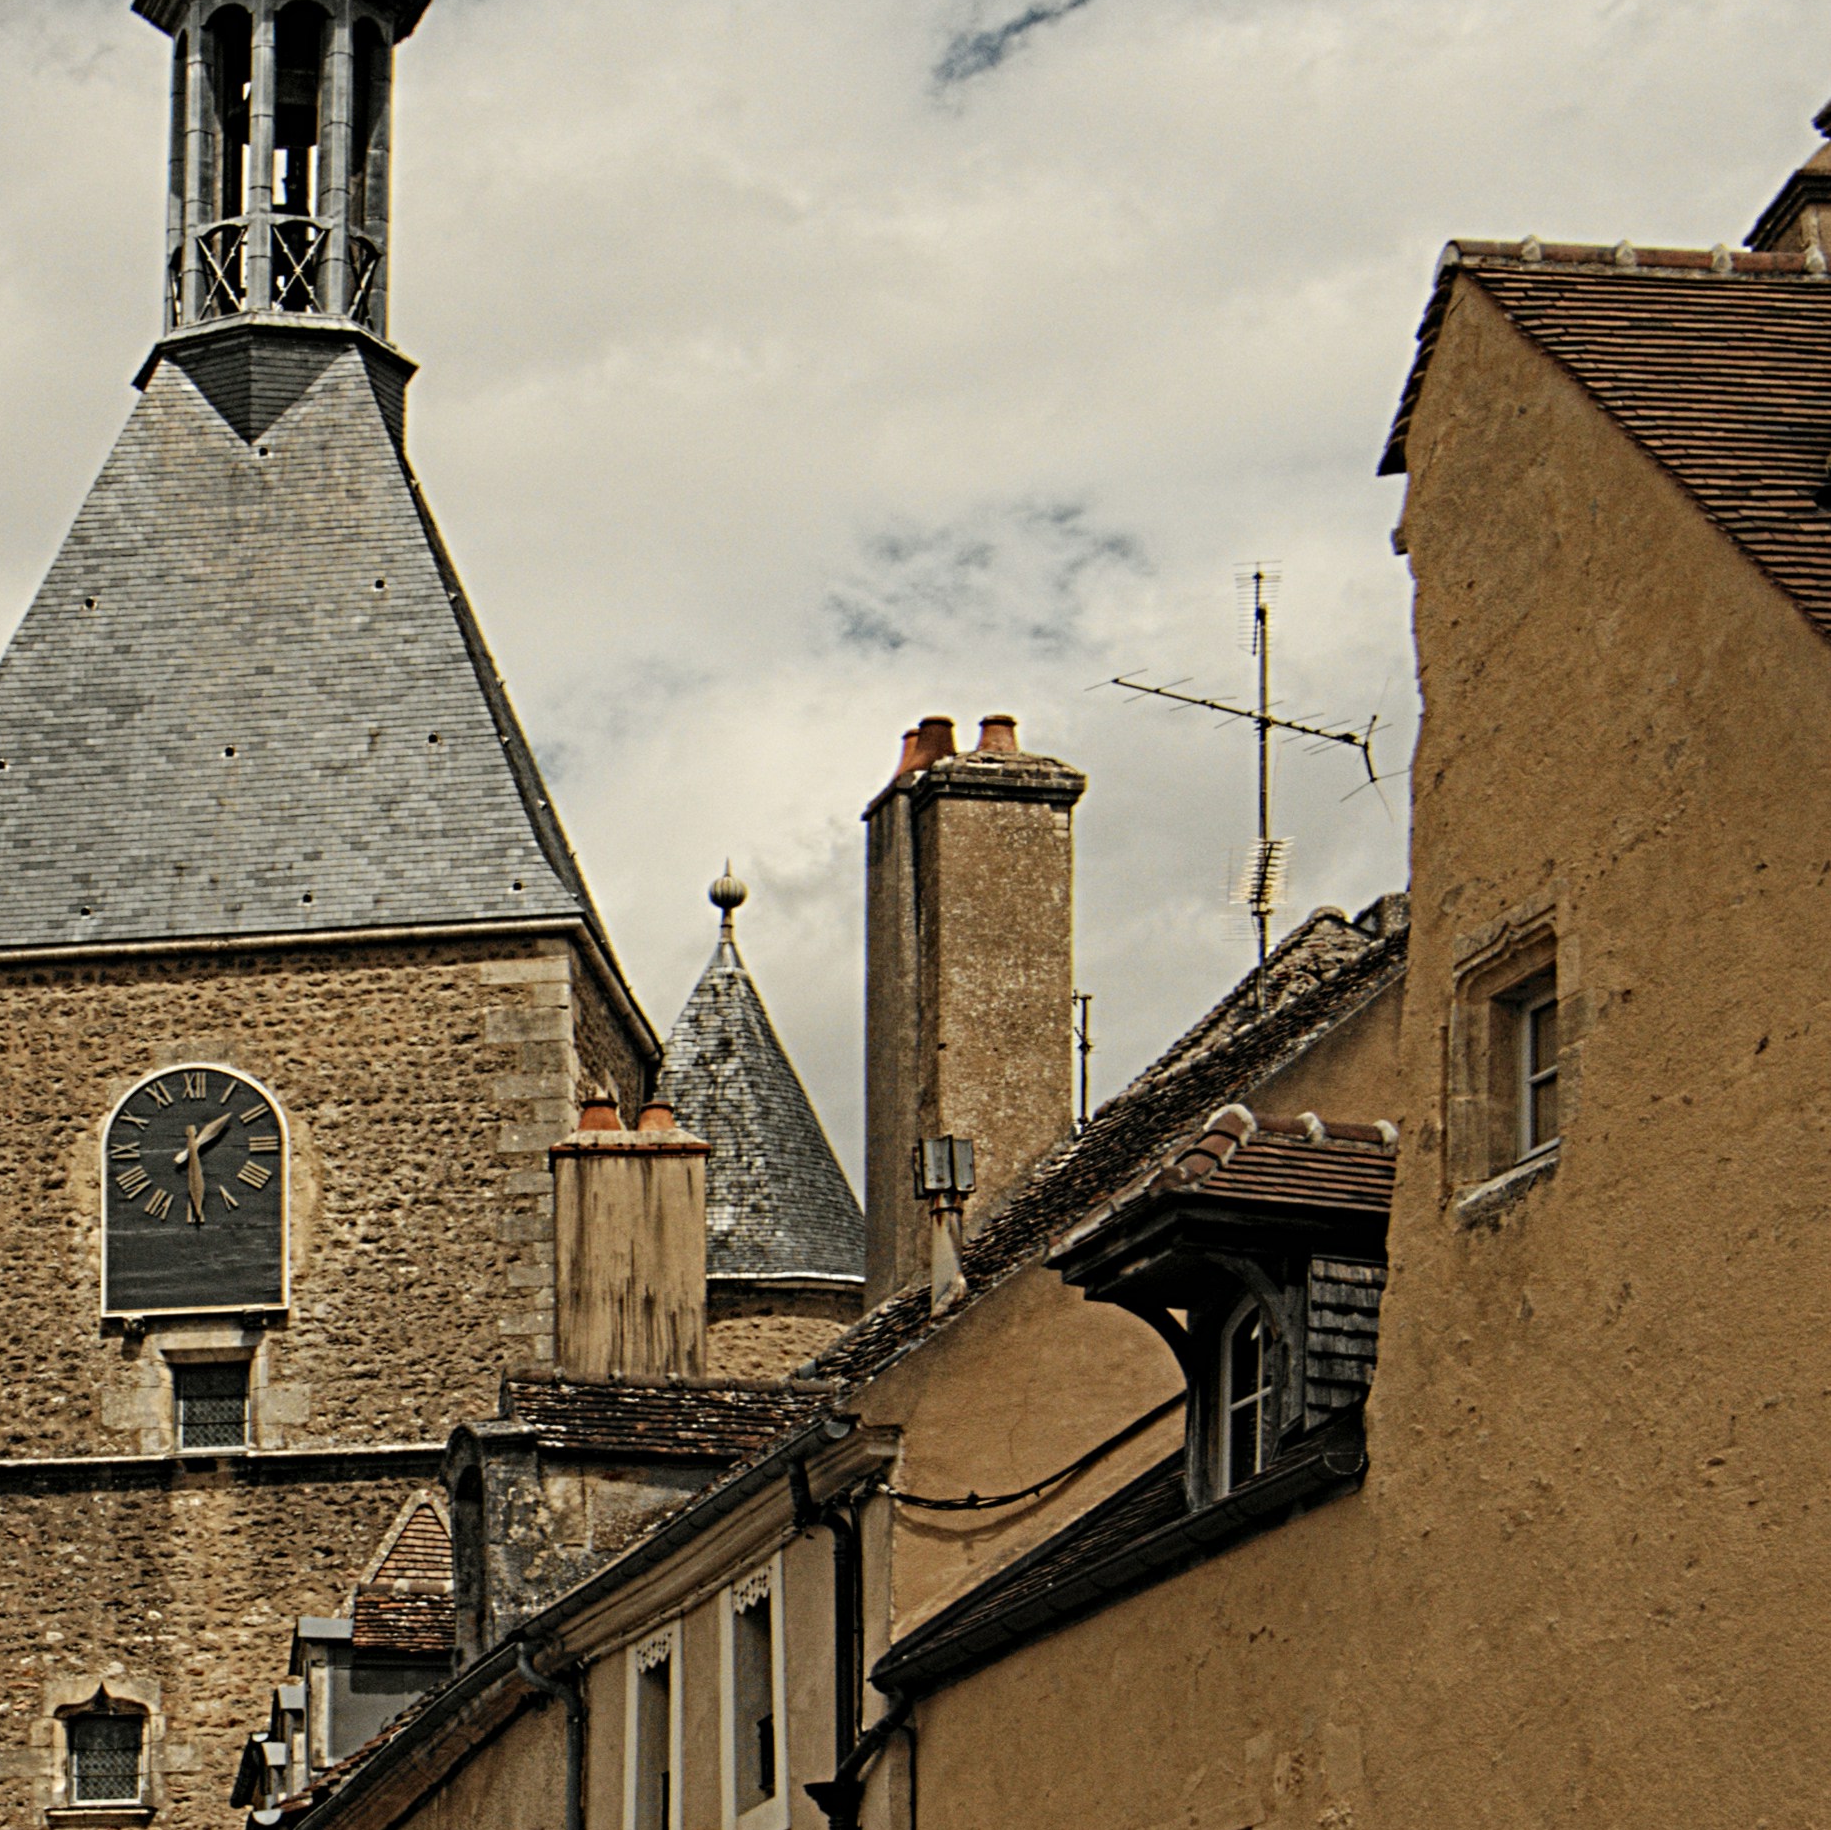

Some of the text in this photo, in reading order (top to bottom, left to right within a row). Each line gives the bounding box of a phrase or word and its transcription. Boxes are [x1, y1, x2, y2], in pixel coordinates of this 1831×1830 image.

[145, 1080, 174, 1109] XI
[182, 1072, 207, 1099] XII
[220, 1080, 238, 1104] I
[119, 1109, 149, 1130] X
[240, 1102, 269, 1124] II
[110, 1141, 140, 1159] IX
[249, 1136, 278, 1152] III
[115, 1165, 153, 1199] VIII
[237, 1160, 272, 1189] IIII
[144, 1188, 174, 1221] VII
[219, 1185, 239, 1213] V
